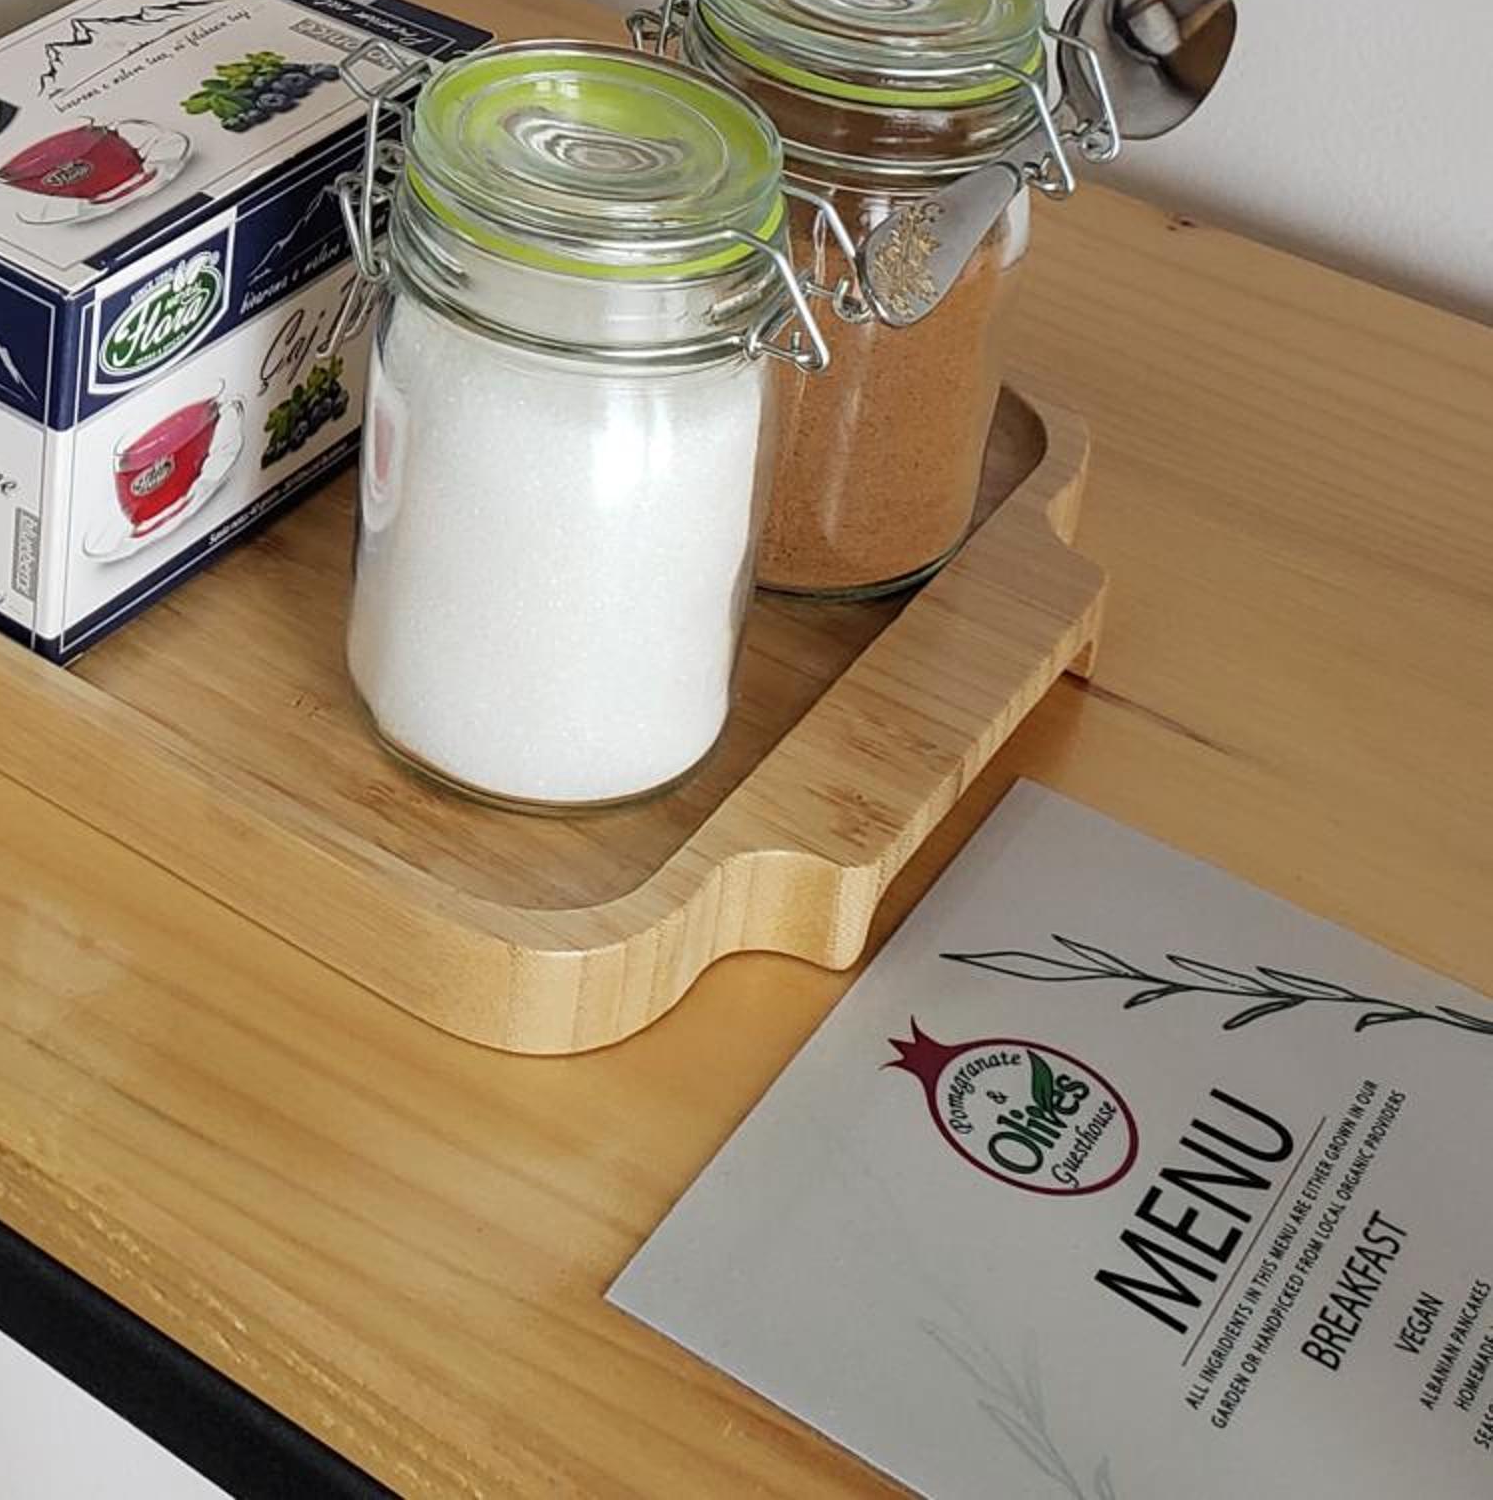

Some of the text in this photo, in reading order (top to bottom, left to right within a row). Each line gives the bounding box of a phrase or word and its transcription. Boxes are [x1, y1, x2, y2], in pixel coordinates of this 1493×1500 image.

[112, 282, 210, 367] Flora
[257, 309, 325, 396] Çaj
[948, 1052, 1022, 1135] Pomegranate
[986, 1089, 1008, 1105] &
[988, 1072, 1091, 1174] Olives
[1051, 1100, 1118, 1189] Guesthouse
[1094, 1088, 1294, 1335] MENU
[1185, 1080, 1379, 1411] ALL INGRIDIENTS IN THIS MENU ARE EITHER GROWN IN OUR
[1211, 1089, 1407, 1430] GARDEN OR HANDPICKED FROM LOCAL ORGANIC PROVIDERS
[1301, 1209, 1408, 1372] BREAKFAST
[1394, 1291, 1445, 1355] VEGAN
[1419, 1278, 1493, 1411] ALBANIAN PANCAKES
